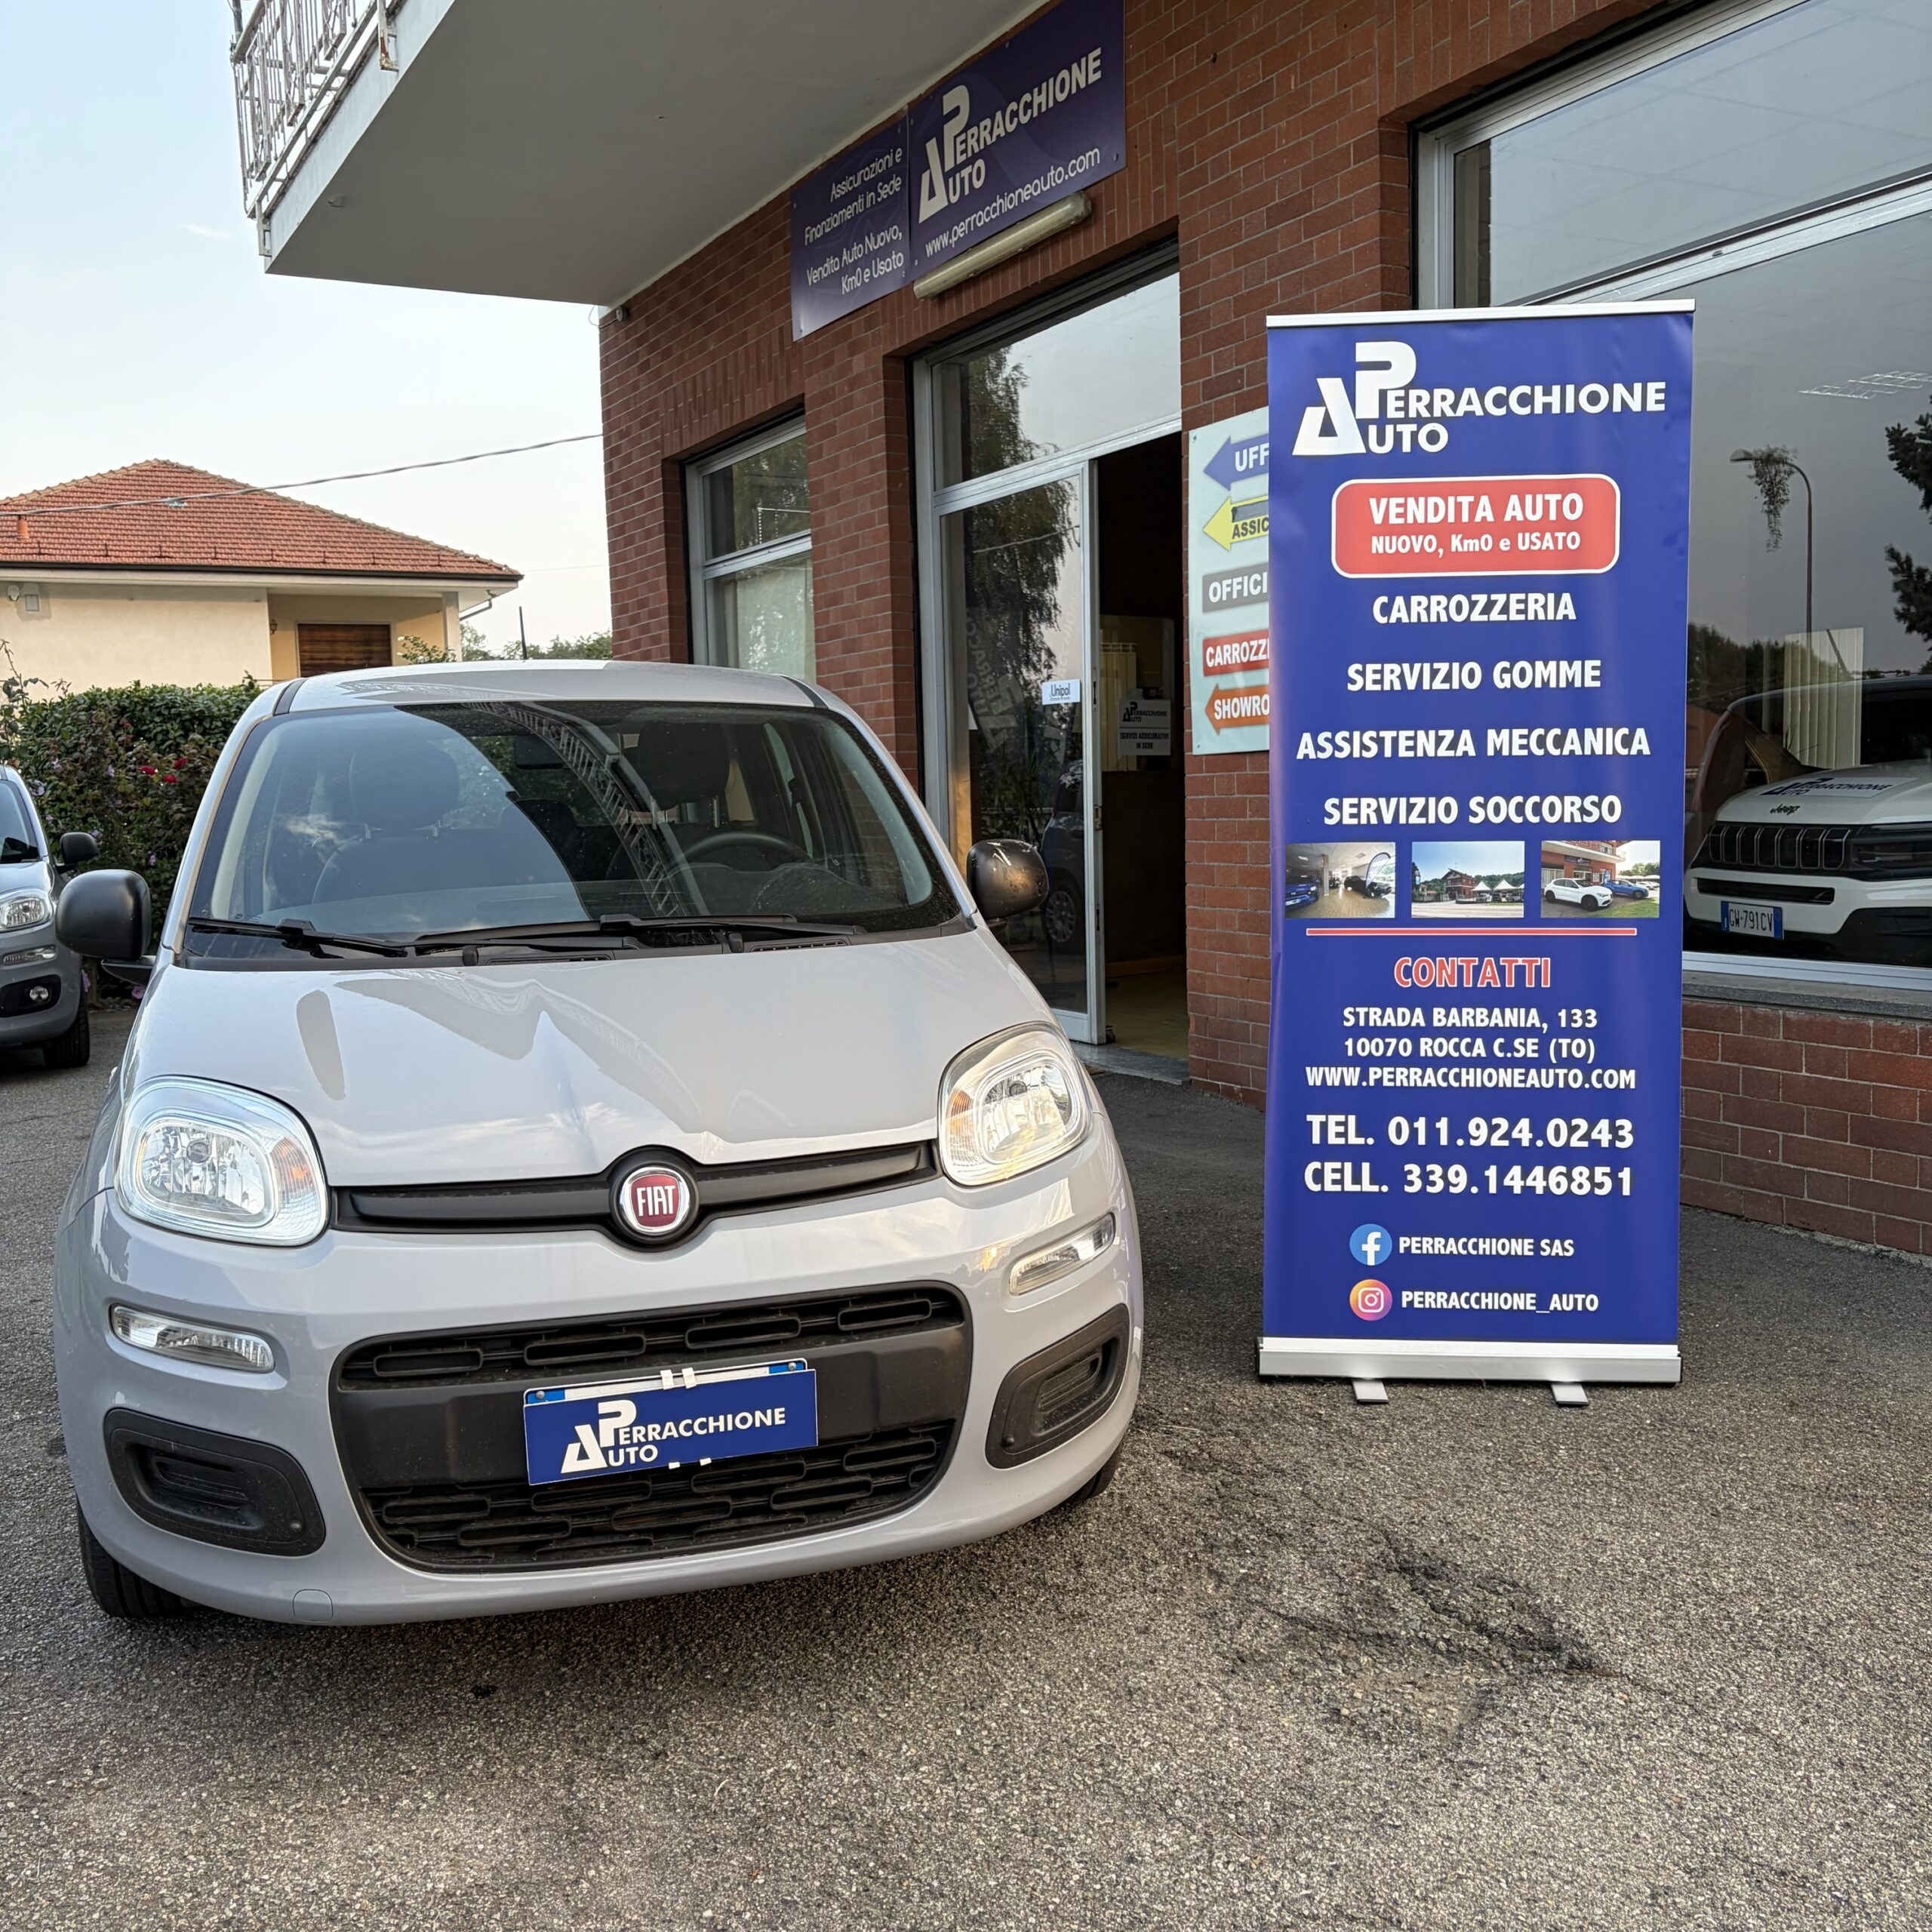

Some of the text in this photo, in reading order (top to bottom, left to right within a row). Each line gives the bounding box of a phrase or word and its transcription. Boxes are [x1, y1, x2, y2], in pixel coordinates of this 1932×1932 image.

[943, 47, 1102, 172] PERRACCHIONE
[831, 147, 903, 202] Assicurazioni e
[918, 137, 986, 224] AUTO
[804, 174, 902, 246] Finanziamenti in Sede
[925, 147, 1100, 257] www.perracchioneauto.com
[807, 225, 903, 286] Vendita Auto Nuovo,
[841, 251, 904, 294] Km0 e Usato
[1355, 340, 1666, 420] PERRACCHIONE
[1292, 377, 1449, 456] AUTO
[1235, 442, 1269, 472] UFF
[1369, 493, 1583, 525] VENDITA AUTO
[1232, 517, 1269, 540] ASSIC
[1371, 531, 1580, 558] NUOVO, Km0 e USATO
[1208, 571, 1268, 603] OFFICI
[1373, 592, 1577, 624] CARROZZERIA
[1051, 683, 1071, 700] Unipol
[1347, 660, 1601, 691] SERVIZIO GOMME
[1214, 694, 1270, 720] SHOWRO
[1297, 728, 1651, 760] ASSISTENZA MECCANICA
[1324, 795, 1622, 826] SERVIZIO SOCCORSO
[1770, 804, 1800, 815] Jeep
[1393, 957, 1551, 989] CONTATTI
[1343, 1008, 1598, 1033] STRADA BARBANIA, 133
[1345, 1038, 1595, 1064] 10070 ROCCA C.SE (TO)
[1306, 1066, 1636, 1090] WWW.PERRACCHIONEAUTO.COM
[1306, 1115, 1634, 1149] TEL. 011.924.0243
[1304, 1161, 1632, 1196] CELL. 339.1446851
[636, 1185, 676, 1217] FIAT
[1398, 1236, 1534, 1257] PERRACCHIONE
[1540, 1239, 1574, 1257] SAS
[1401, 1291, 1599, 1314] PERRACCHIONE_AUTO
[598, 1399, 786, 1447] PERRACCHIONE
[561, 1424, 658, 1474] AUTO
